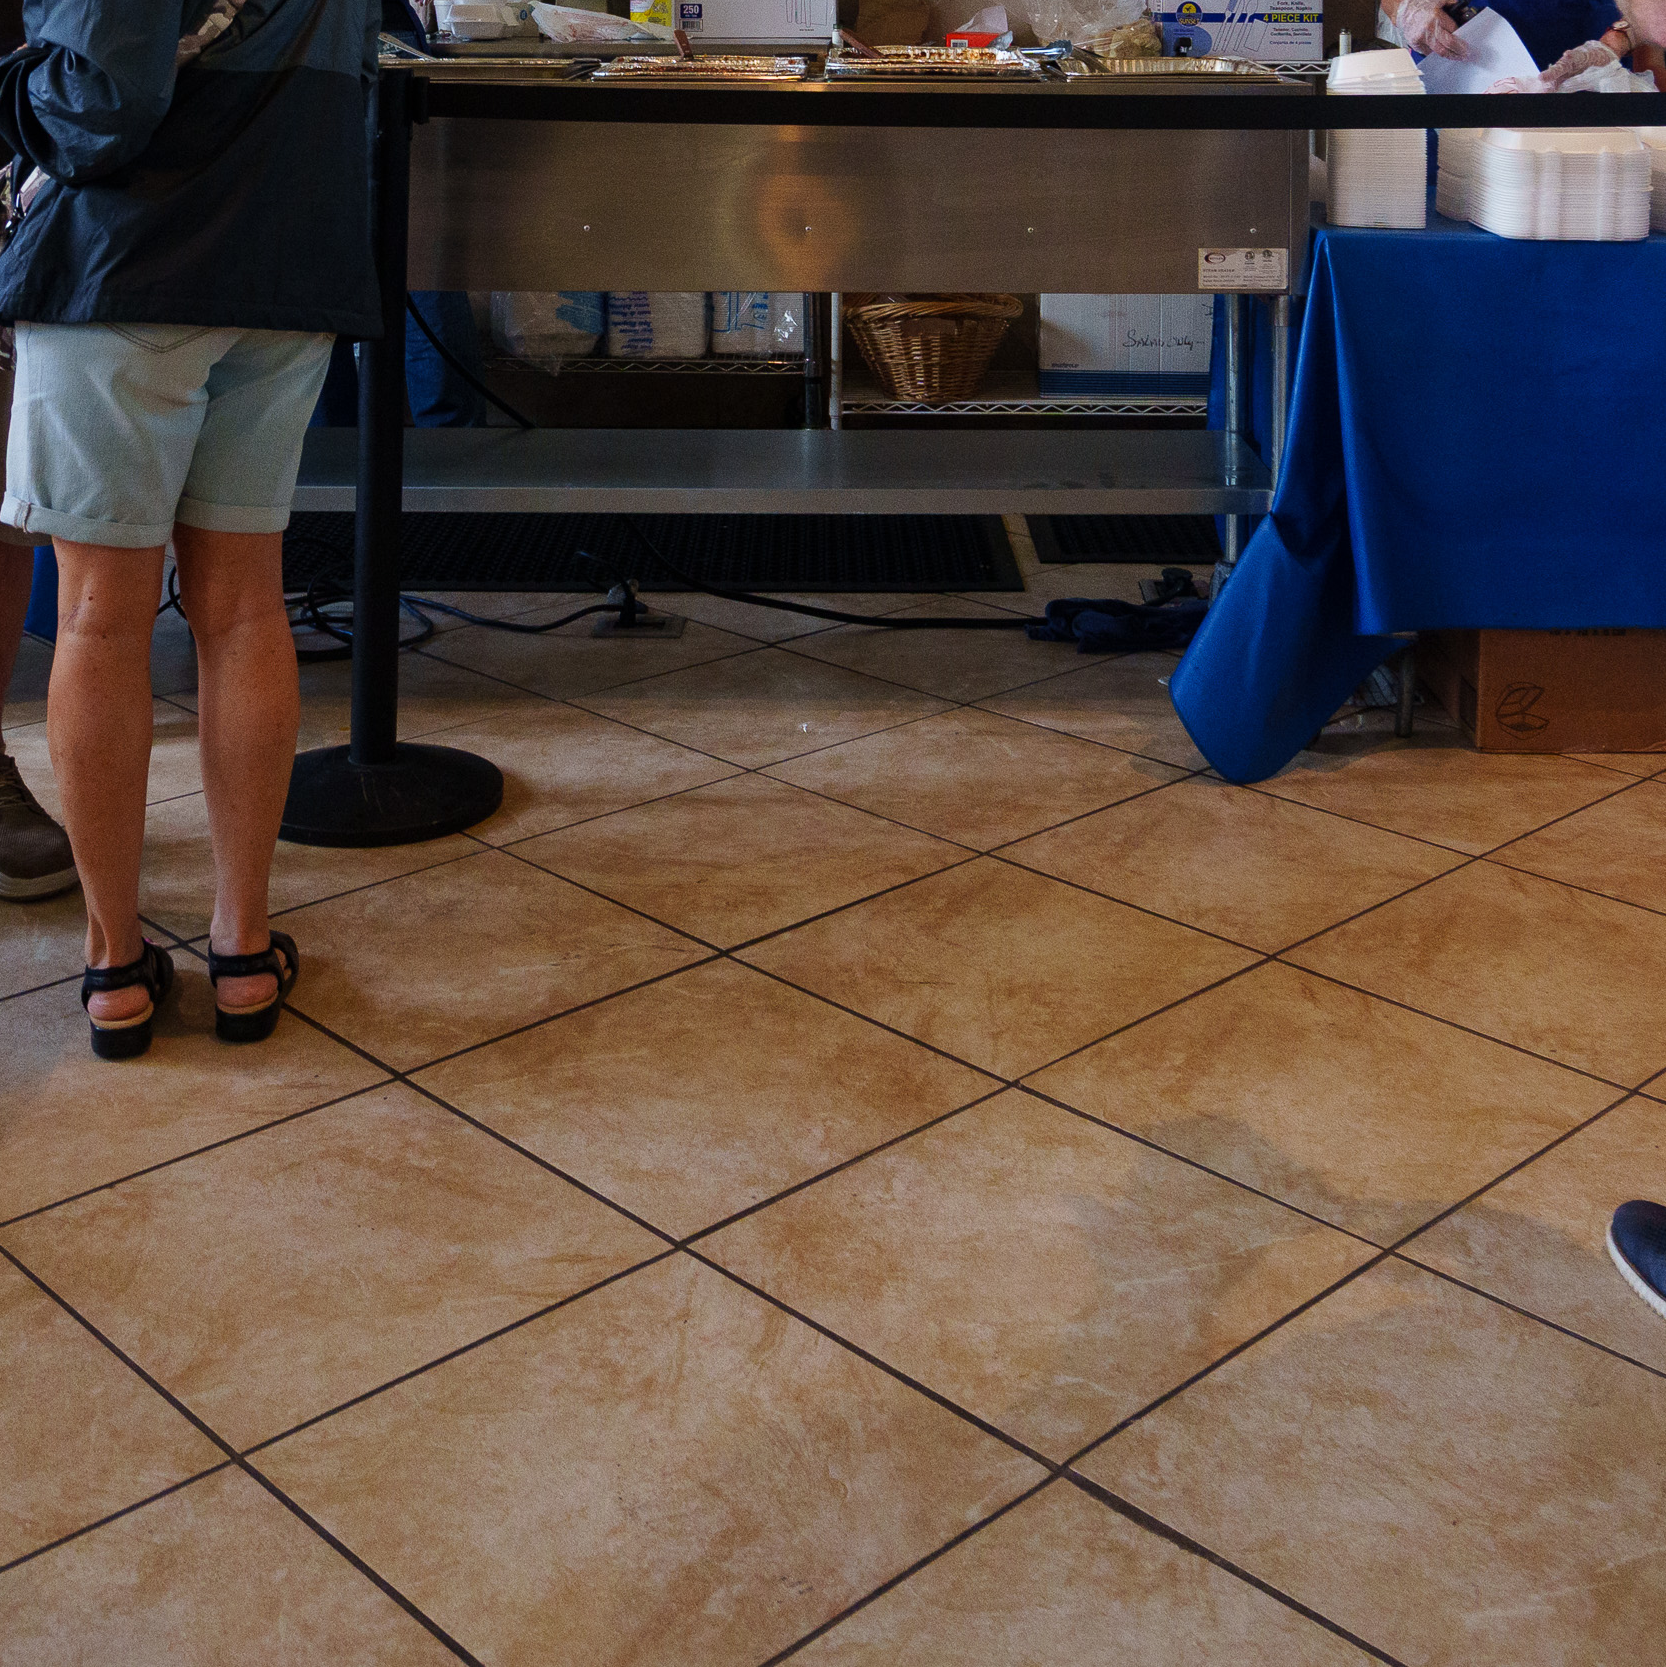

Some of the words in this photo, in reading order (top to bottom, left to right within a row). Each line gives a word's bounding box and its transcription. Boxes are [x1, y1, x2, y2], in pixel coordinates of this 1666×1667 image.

[683, 5, 700, 14] 250
[1263, 14, 1269, 22] 4
[1271, 14, 1300, 22] PIECE
[1303, 14, 1318, 22] KIT
